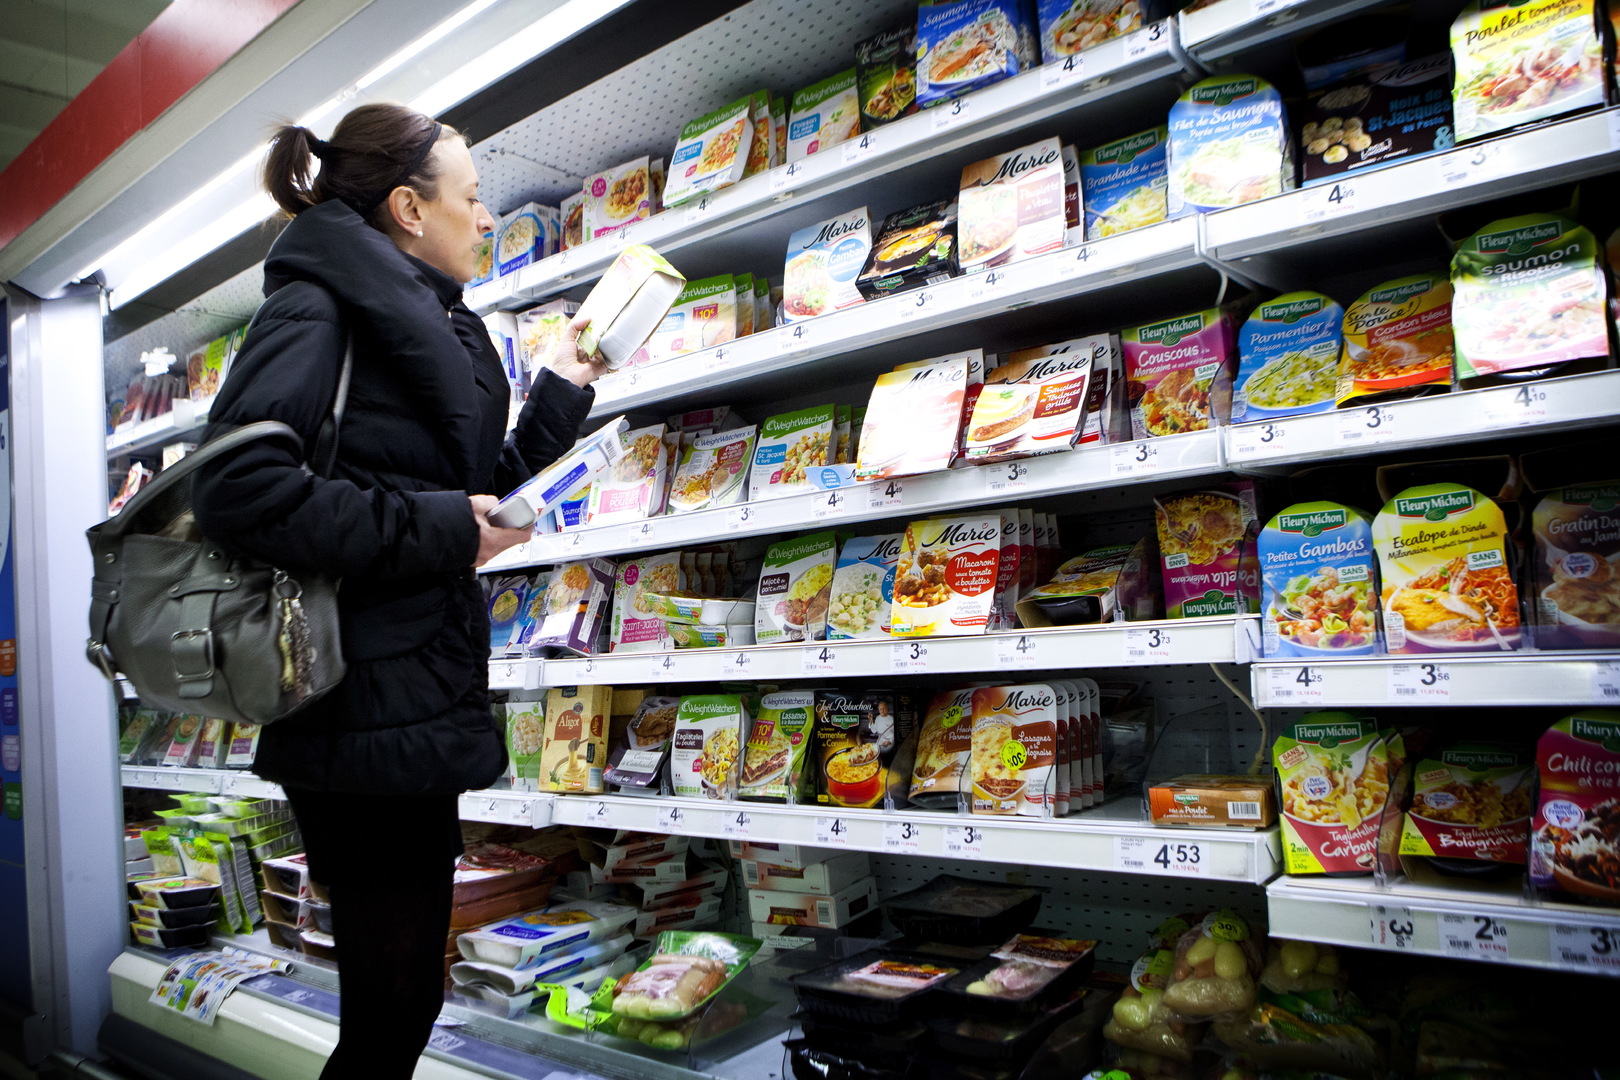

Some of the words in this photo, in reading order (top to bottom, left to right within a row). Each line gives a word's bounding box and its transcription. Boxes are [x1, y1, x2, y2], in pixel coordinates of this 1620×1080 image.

[923, 3, 968, 28] Saumon
[1465, 9, 1526, 46] Poulet
[1194, 87, 1220, 101] Fleury
[1220, 82, 1252, 97] Michon
[1175, 120, 1195, 132] Filet
[1196, 117, 1209, 127] de
[1210, 102, 1275, 126] Saumon
[1189, 127, 1213, 139] Purée
[1433, 125, 1455, 149] &
[1098, 146, 1122, 160] Fleury
[1123, 135, 1154, 151] Michon
[981, 150, 1060, 186] Marie
[1086, 165, 1140, 190] Brandade
[803, 217, 866, 249] Marie
[1482, 234, 1515, 248] Fleury
[1516, 226, 1557, 242] Michon
[1481, 244, 1581, 276] saumon
[1501, 262, 1563, 281] Risotto
[1264, 307, 1289, 318] Fleury
[1289, 301, 1319, 313] Michon
[1142, 327, 1168, 340] Fleury
[1168, 319, 1199, 333] Michon
[1374, 317, 1420, 337] Cordon
[1421, 308, 1448, 323] bleu
[1250, 320, 1325, 345] Parmentier
[1138, 346, 1199, 367] Couscous
[1254, 343, 1281, 353] Poisson
[1006, 357, 1089, 385] Marie
[1134, 364, 1171, 378] Marocaine
[1198, 364, 1217, 374] SANS
[894, 369, 965, 395] Marie
[1043, 381, 1081, 395] Saucisse
[1046, 388, 1081, 402] Toulouse
[774, 413, 829, 431] WeightWatchers
[701, 432, 746, 447] WeightWatchers
[1399, 501, 1431, 512] Fleury
[1431, 495, 1469, 509] Michon
[1282, 515, 1309, 527] Fleury
[1310, 513, 1342, 525] Michon
[1549, 515, 1598, 534] Gratin
[922, 523, 998, 547] Marie
[1393, 530, 1448, 549] Escalope
[1449, 528, 1460, 536] de
[1461, 521, 1488, 534] Dinde
[775, 541, 830, 559] WeightWatchers
[1267, 551, 1298, 563] Petites
[1300, 537, 1365, 558] Gambas
[1472, 551, 1497, 562] SANS
[955, 556, 995, 569] Macaroni
[1169, 558, 1187, 568] SANS
[969, 568, 993, 577] tomate
[1212, 570, 1258, 587] Paella
[1342, 567, 1364, 576] SANS
[762, 578, 781, 586] Mijoté
[961, 577, 990, 587] boulettes
[1186, 603, 1218, 614] Michon
[768, 697, 805, 707] WeightWatchers
[834, 696, 873, 714] Robuchon
[992, 690, 1054, 711] Marie
[688, 704, 737, 716] WeightWatchers
[821, 712, 830, 723] &
[558, 716, 580, 730] Aligot
[1576, 721, 1613, 739] Fleury
[676, 733, 703, 741] Tagliatelles
[817, 731, 847, 739] Parmentier
[1017, 731, 1052, 743] Lasagnes
[1299, 728, 1325, 741] Fleury
[1326, 727, 1358, 738] Michon
[1026, 748, 1052, 760] lognaise
[1282, 747, 1300, 761] SANS
[1447, 753, 1476, 764] Fleury
[1478, 755, 1513, 764] Michon
[1548, 753, 1592, 773] Chili
[1578, 775, 1593, 787] et
[1596, 776, 1613, 788] riz
[1184, 805, 1208, 814] Poulet
[1328, 823, 1380, 845] Tagliatelles
[1437, 832, 1527, 851] Bolognaise
[1290, 842, 1297, 853] 2
[1297, 844, 1309, 853] min
